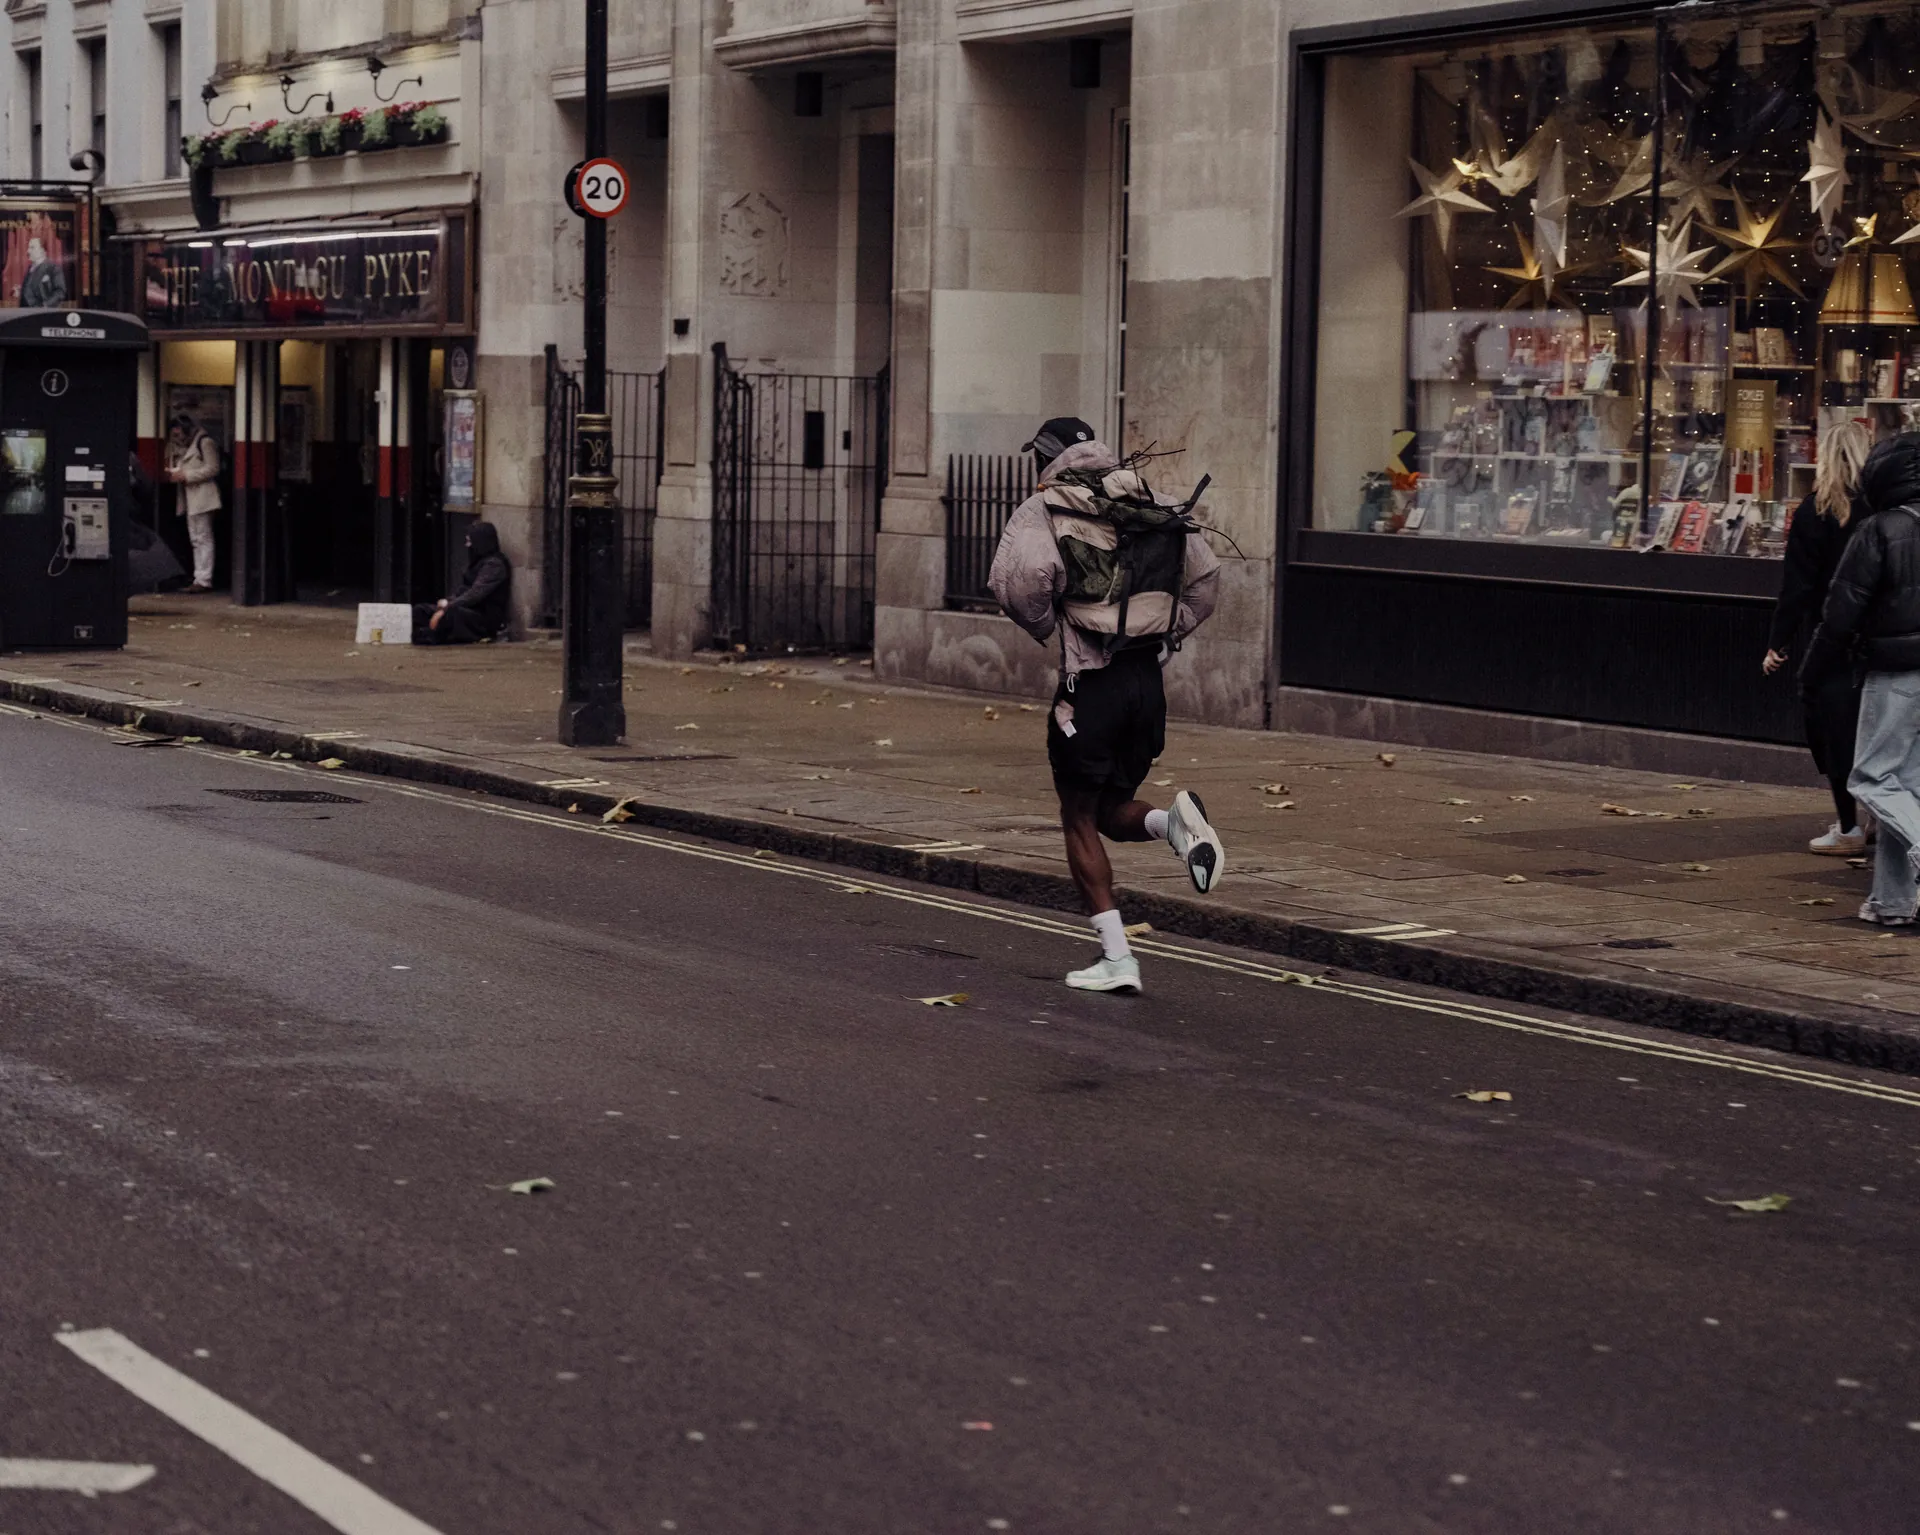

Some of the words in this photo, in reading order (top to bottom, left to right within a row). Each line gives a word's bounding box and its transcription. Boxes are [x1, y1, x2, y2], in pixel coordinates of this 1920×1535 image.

[586, 176, 621, 200] 20
[161, 265, 200, 306] THE
[227, 255, 346, 303] MONTAGU
[364, 249, 431, 298] PYKE
[48, 328, 98, 338] TELEPHONE
